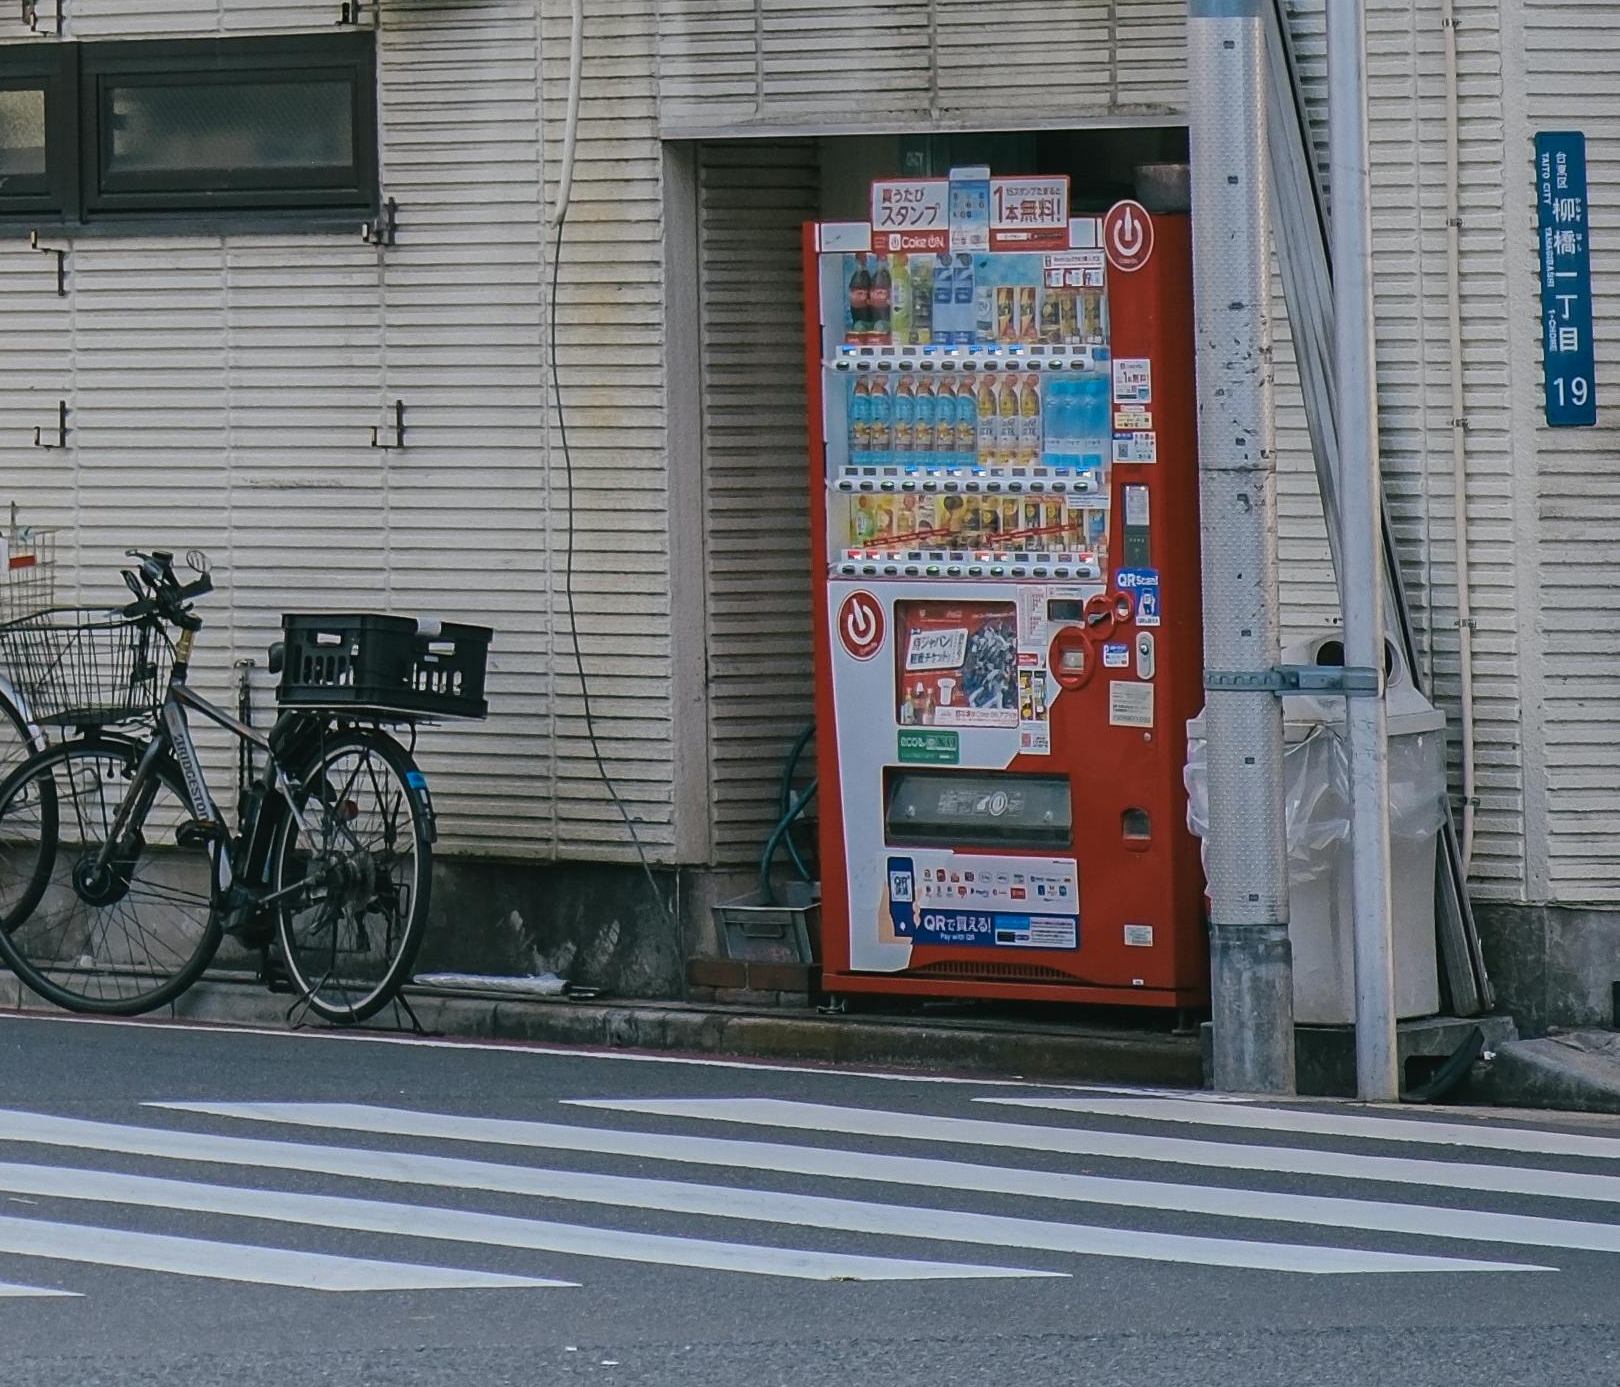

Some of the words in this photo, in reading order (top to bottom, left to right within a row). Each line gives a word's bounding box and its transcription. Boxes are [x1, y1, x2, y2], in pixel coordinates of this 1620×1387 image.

[1542, 153, 1551, 179] TAITO
[1543, 183, 1552, 205] CITY
[881, 203, 941, 227] スタンプ
[1553, 377, 1589, 407] 19
[1117, 574, 1137, 588] QR
[924, 914, 991, 933] QRで買える!
